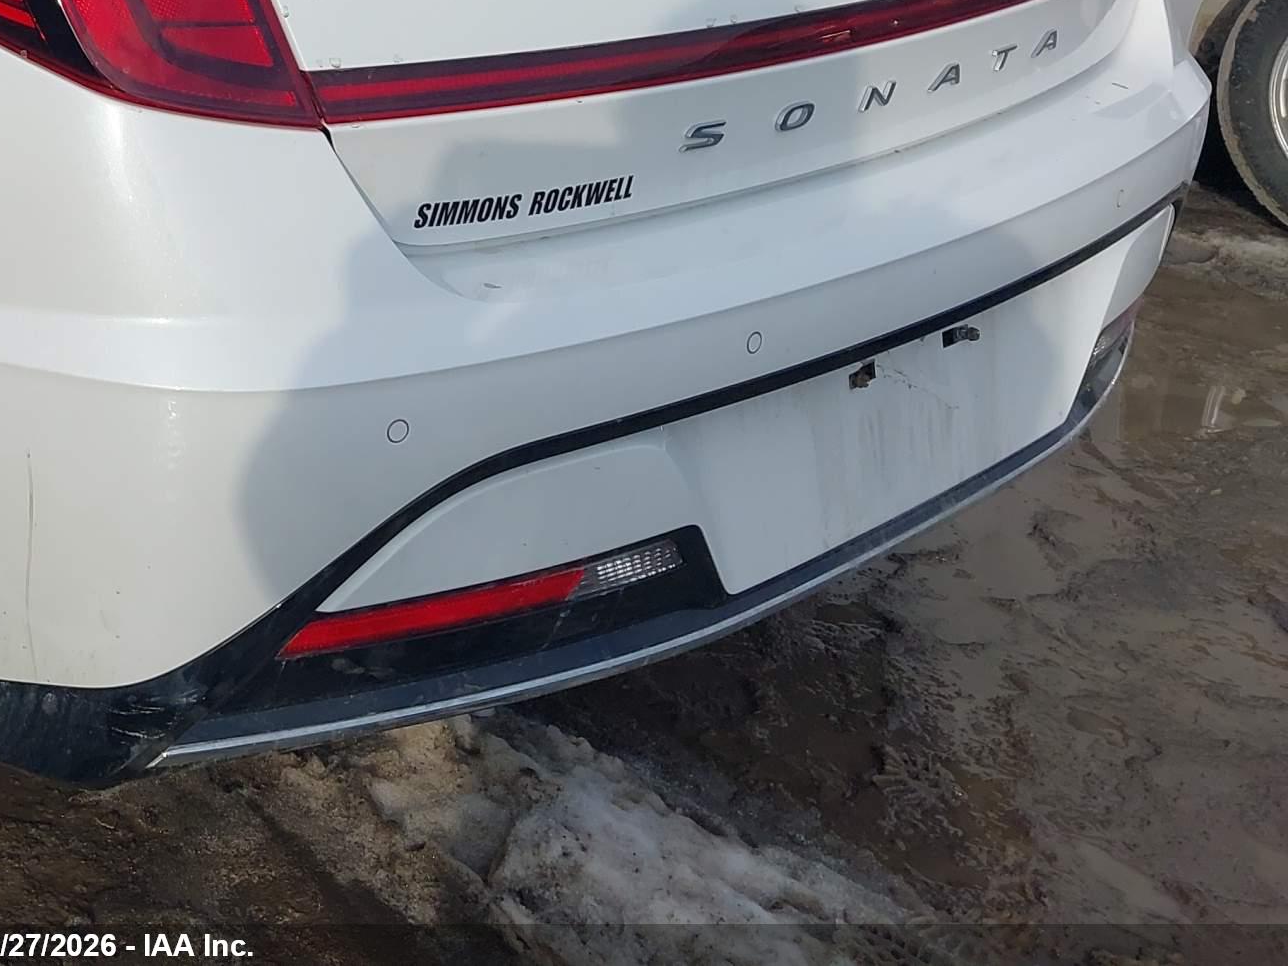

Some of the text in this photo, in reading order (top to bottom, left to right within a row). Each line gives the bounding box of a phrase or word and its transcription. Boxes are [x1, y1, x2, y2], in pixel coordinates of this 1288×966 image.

[678, 28, 1058, 153] SONATA
[413, 175, 634, 230] SIMMONS ROCKWELL
